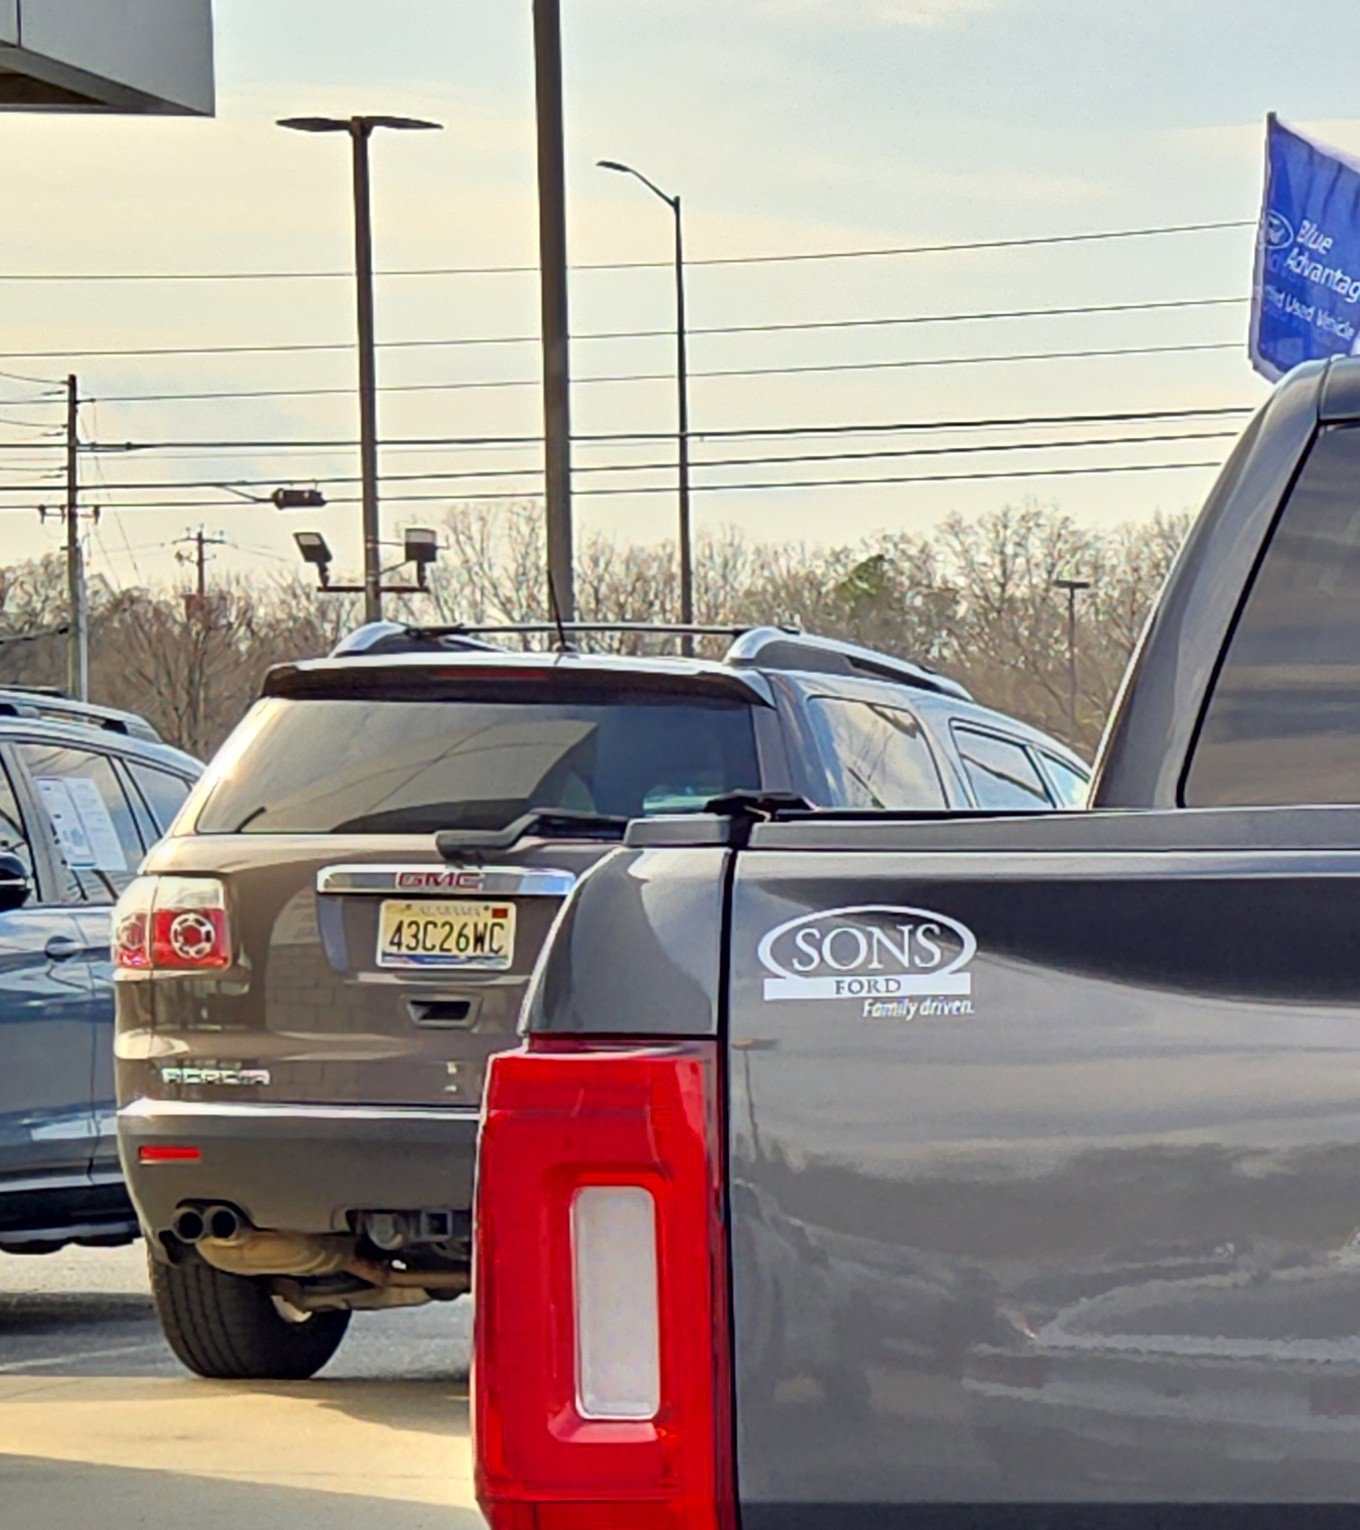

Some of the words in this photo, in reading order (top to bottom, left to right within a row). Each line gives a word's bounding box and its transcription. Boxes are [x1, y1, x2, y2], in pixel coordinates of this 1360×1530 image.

[1297, 219, 1333, 254] Blue
[397, 871, 483, 889] GMC
[388, 919, 506, 954] 43C26WC
[792, 923, 943, 972] SONS
[834, 978, 902, 996] FORD
[862, 997, 919, 1021] Family
